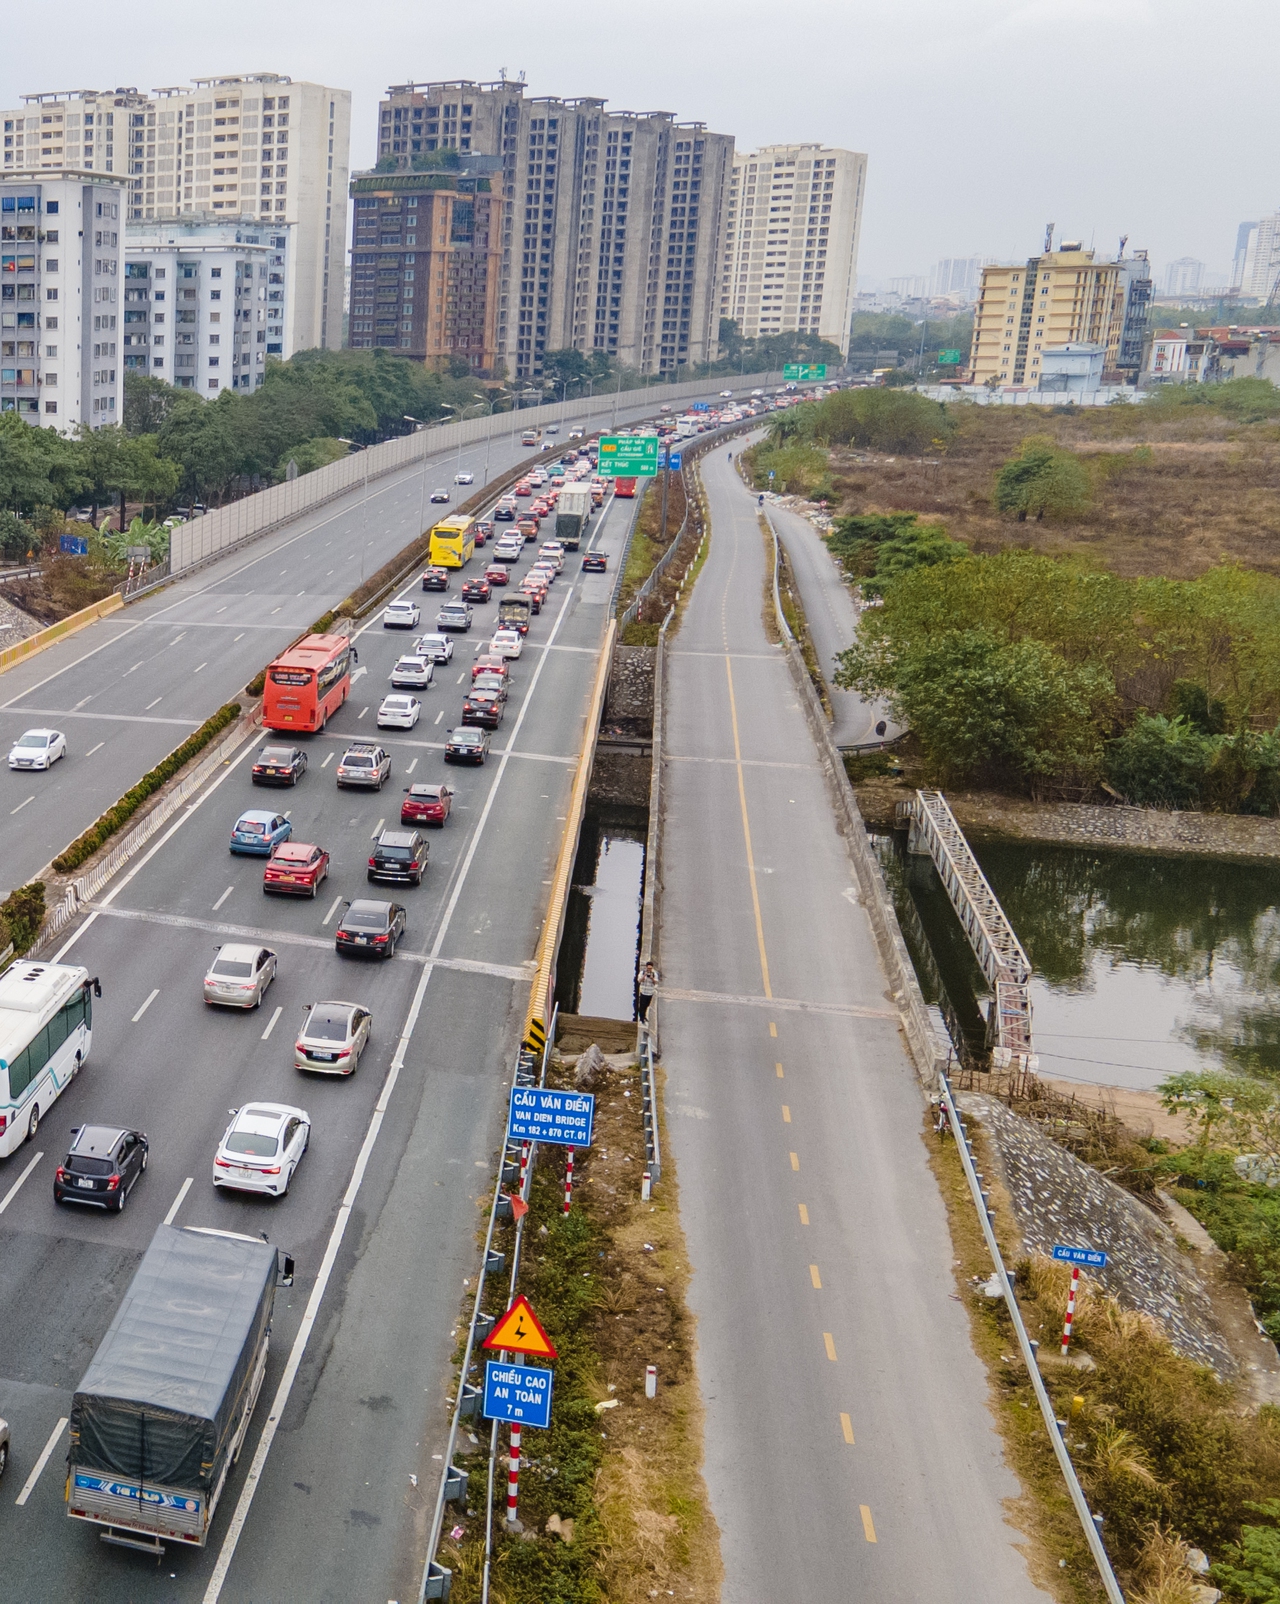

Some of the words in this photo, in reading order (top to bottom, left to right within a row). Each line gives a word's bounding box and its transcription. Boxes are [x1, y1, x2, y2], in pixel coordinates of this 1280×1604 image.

[514, 1091, 536, 1107] CẦU
[540, 1095, 561, 1110] VĂN
[515, 1110, 531, 1121] VAN
[534, 1112, 553, 1123] DIEN
[555, 1115, 586, 1127] BRIDGE
[513, 1124, 526, 1133] Km
[528, 1126, 540, 1135] 182
[548, 1128, 561, 1137] 870
[1057, 1248, 1070, 1258] CẦU
[492, 1369, 522, 1385] CHIỀU
[525, 1376, 547, 1390] CAO
[494, 1387, 509, 1399] AN
[515, 1389, 542, 1405] TOÀN
[507, 1404, 513, 1415] 7
[514, 1407, 523, 1417] m
